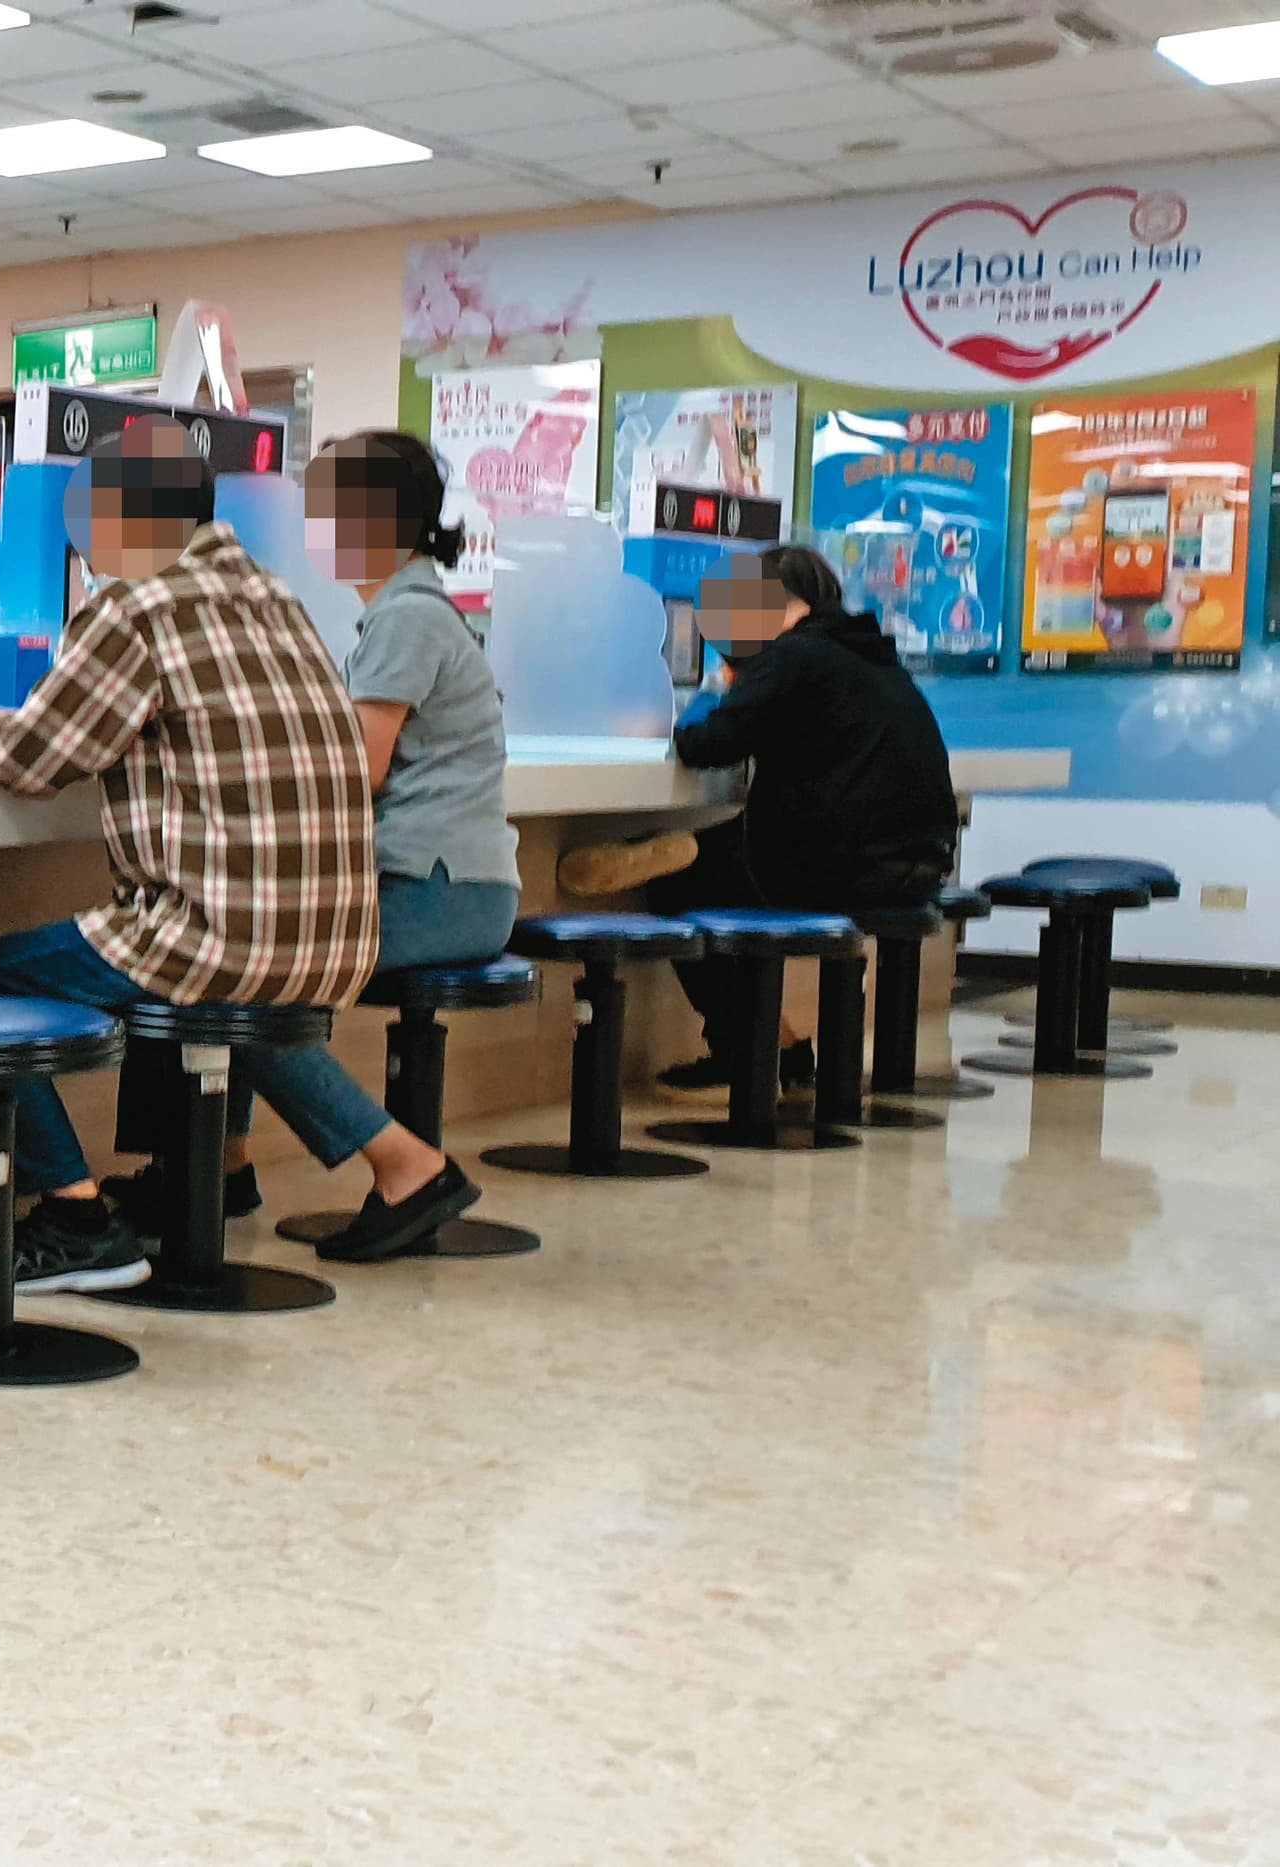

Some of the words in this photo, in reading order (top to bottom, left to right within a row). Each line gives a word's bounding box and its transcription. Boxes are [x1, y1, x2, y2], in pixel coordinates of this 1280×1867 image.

[867, 247, 1045, 296] Luzhou
[1058, 250, 1120, 279] Can
[1131, 241, 1202, 274] Help
